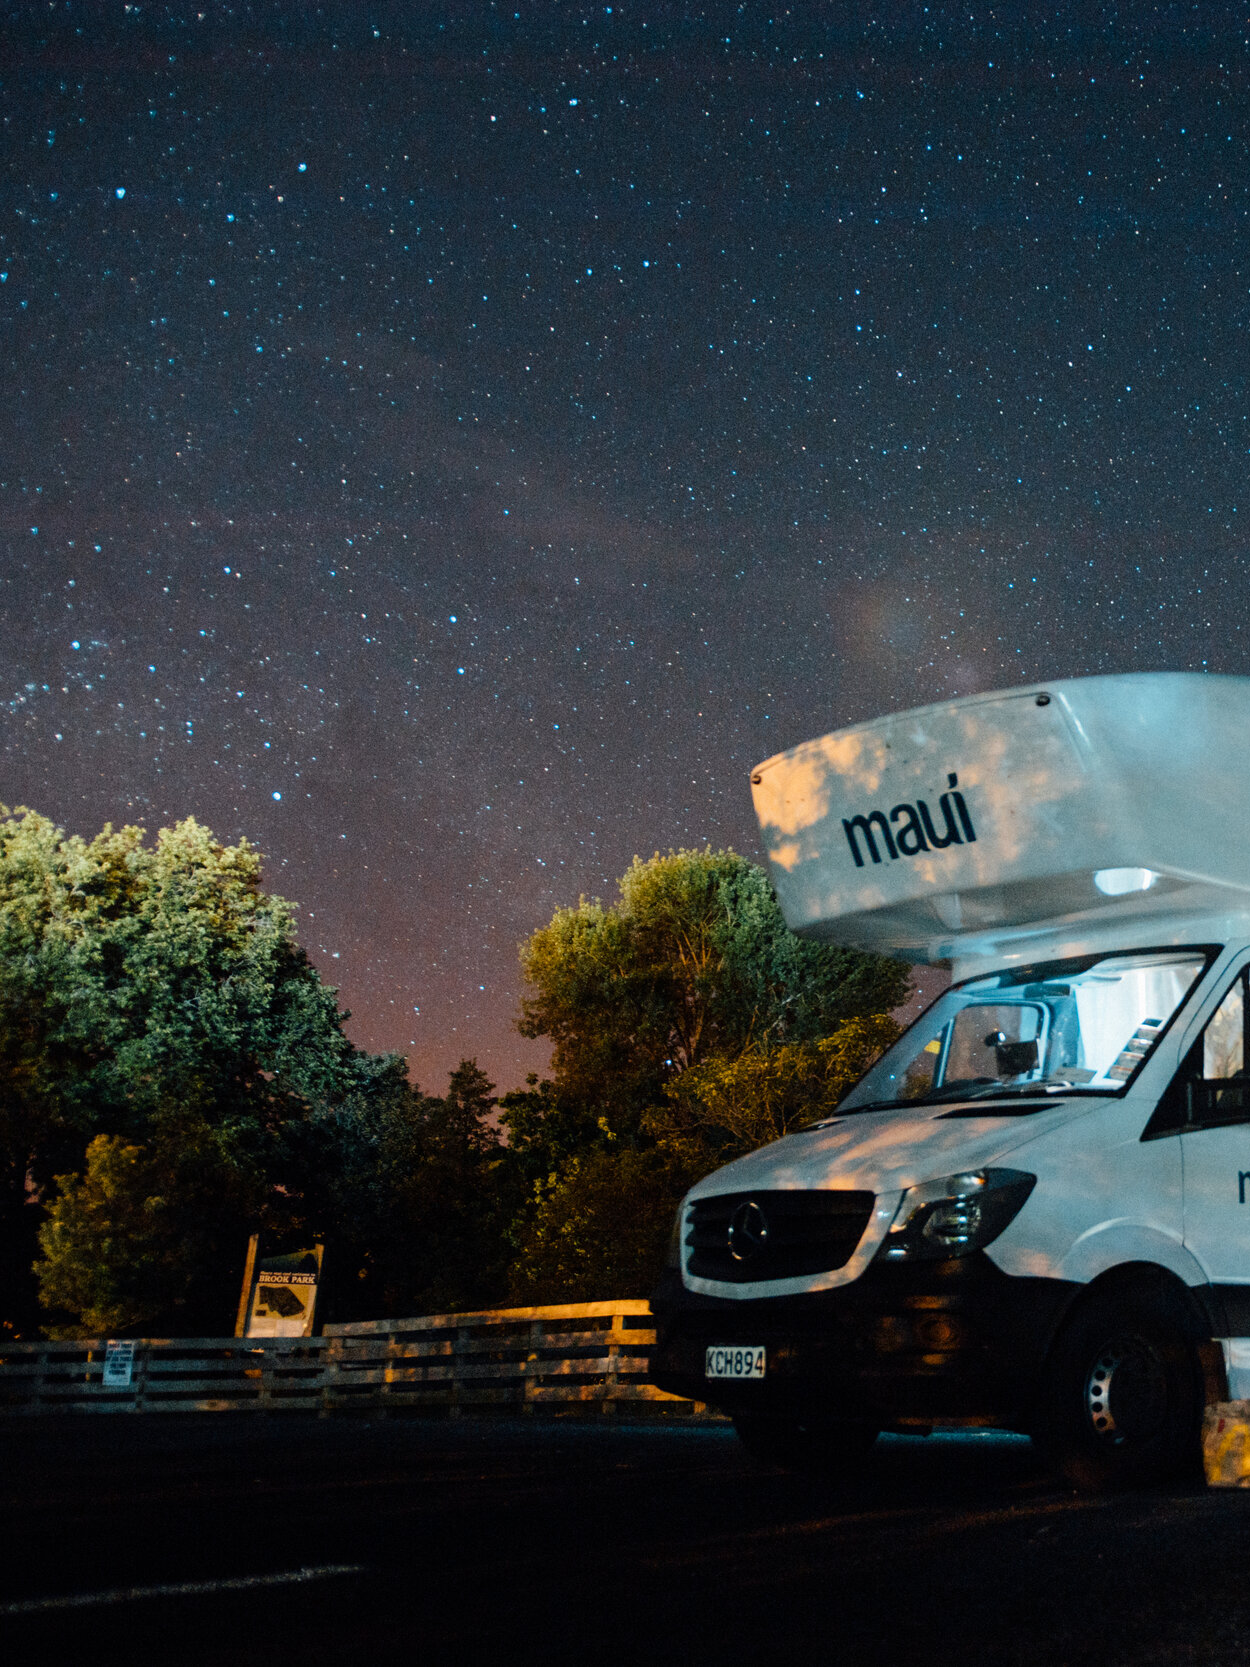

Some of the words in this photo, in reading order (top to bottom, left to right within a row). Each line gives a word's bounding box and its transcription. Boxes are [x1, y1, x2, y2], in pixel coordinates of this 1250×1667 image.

[258, 1275, 289, 1283] BROOK
[291, 1276, 315, 1284] PARK
[706, 1351, 763, 1375] KCH894
